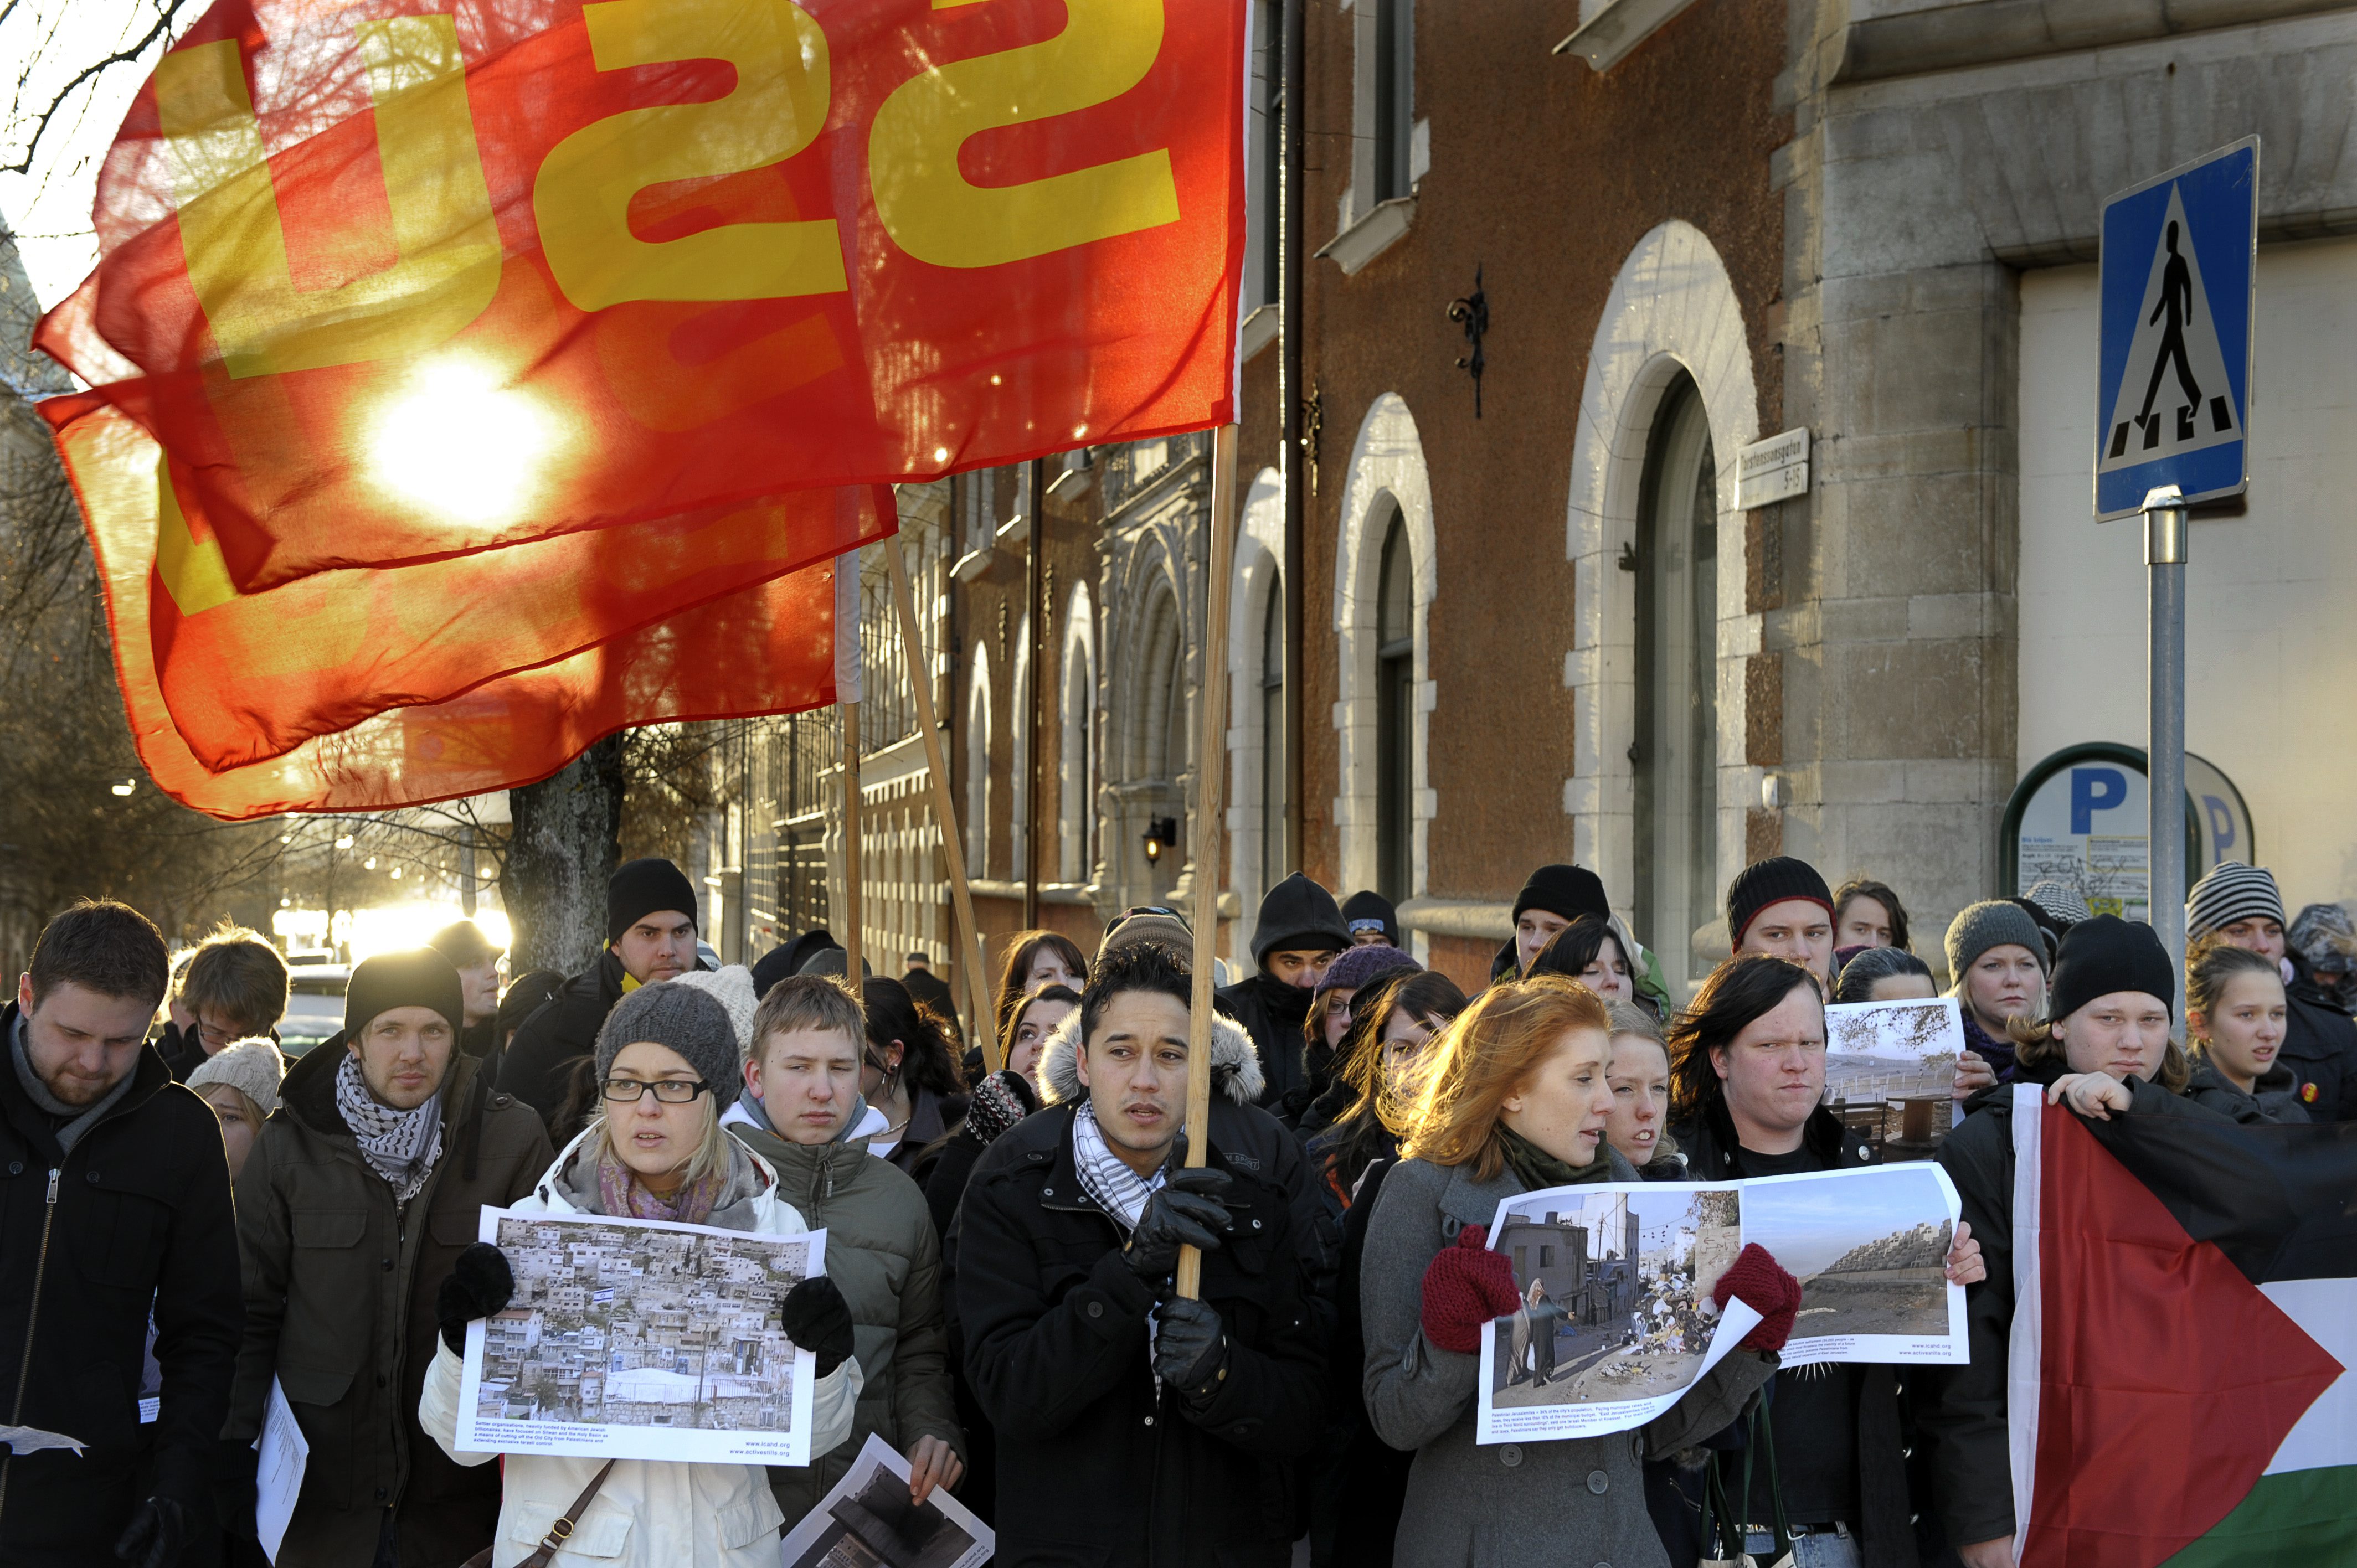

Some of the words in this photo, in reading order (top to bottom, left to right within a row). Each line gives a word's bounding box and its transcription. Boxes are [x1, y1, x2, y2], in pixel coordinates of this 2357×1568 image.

[2071, 768, 2127, 834] P
[2201, 794, 2235, 864] P
[1234, 1155, 1258, 1169] SPORT
